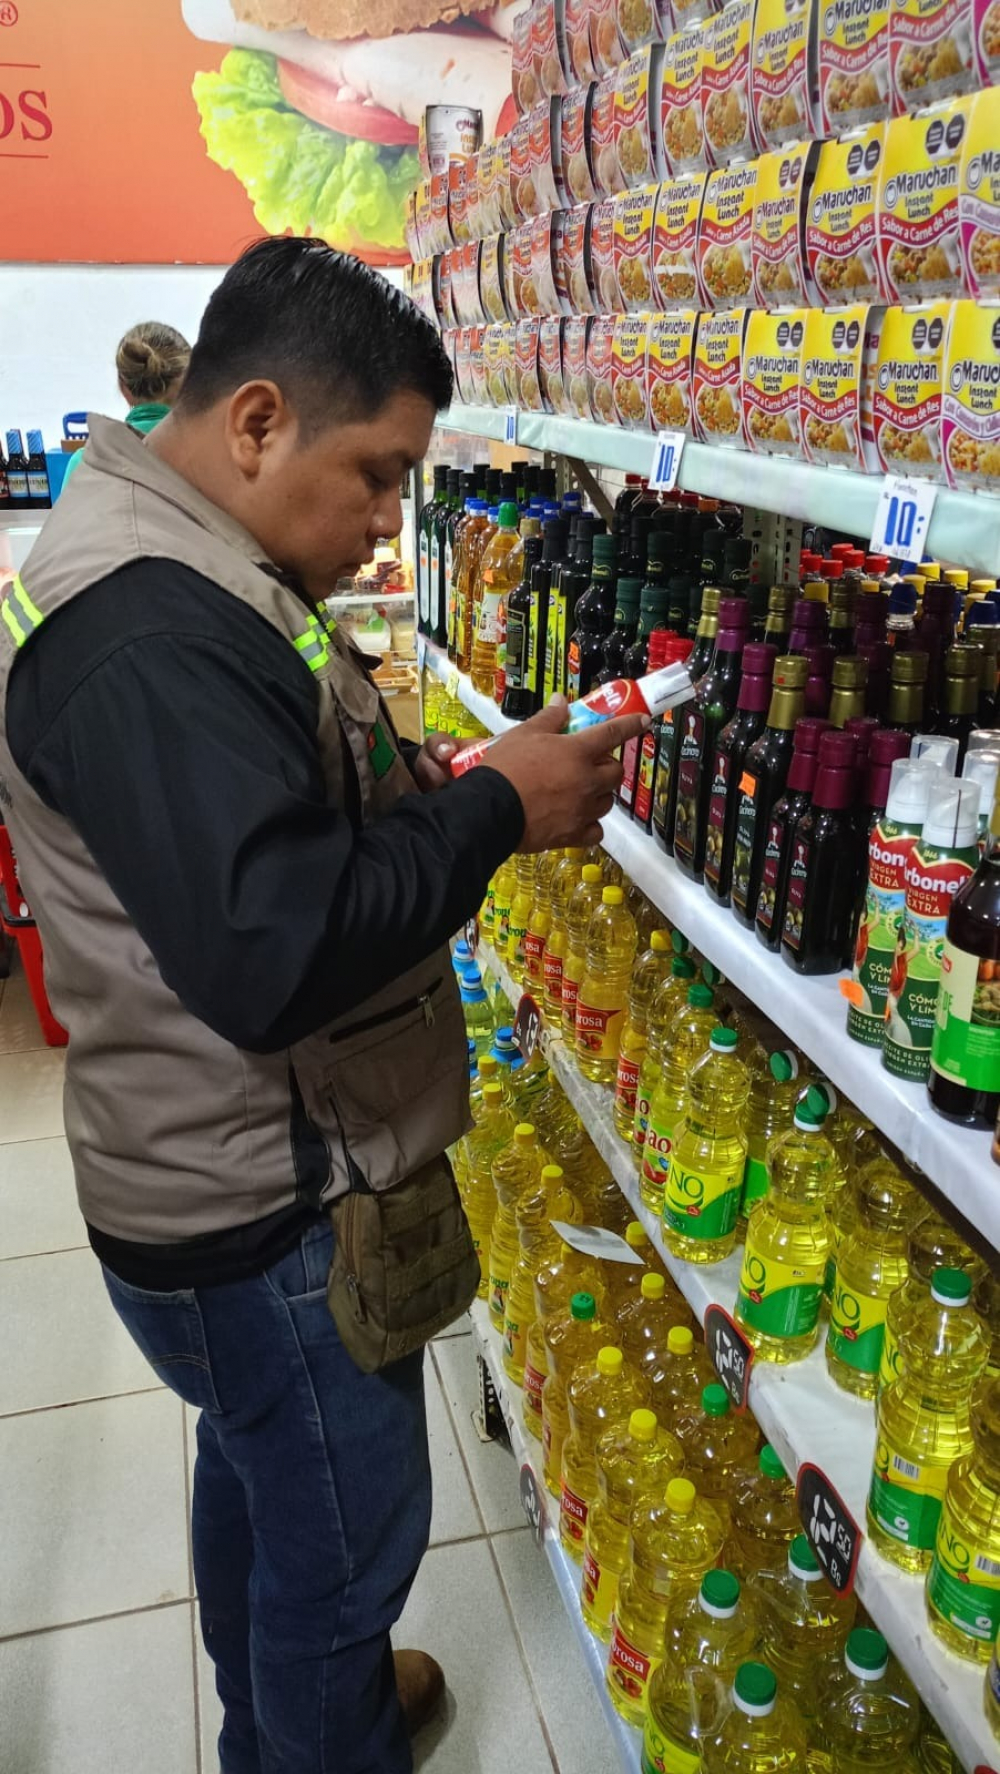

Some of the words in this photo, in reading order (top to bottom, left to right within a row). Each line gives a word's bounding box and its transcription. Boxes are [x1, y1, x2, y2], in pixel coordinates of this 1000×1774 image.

[896, 165, 957, 193] Maruchan
[823, 184, 871, 210] Maruchan
[809, 230, 828, 247] Sabor
[882, 217, 904, 235] Sabor
[910, 225, 933, 242] Carne
[934, 218, 944, 235] de
[756, 356, 798, 373] Maruchan
[812, 360, 853, 378] Maruchan
[889, 361, 937, 381] Maruchan
[896, 394, 917, 404] Lunch
[971, 398, 992, 409] Lunch
[869, 842, 907, 867] rbon
[870, 860, 897, 876] VIRGEN
[869, 870, 899, 888] EXTRA
[907, 887, 938, 903] VIRGEN
[907, 895, 941, 914] EXTRA
